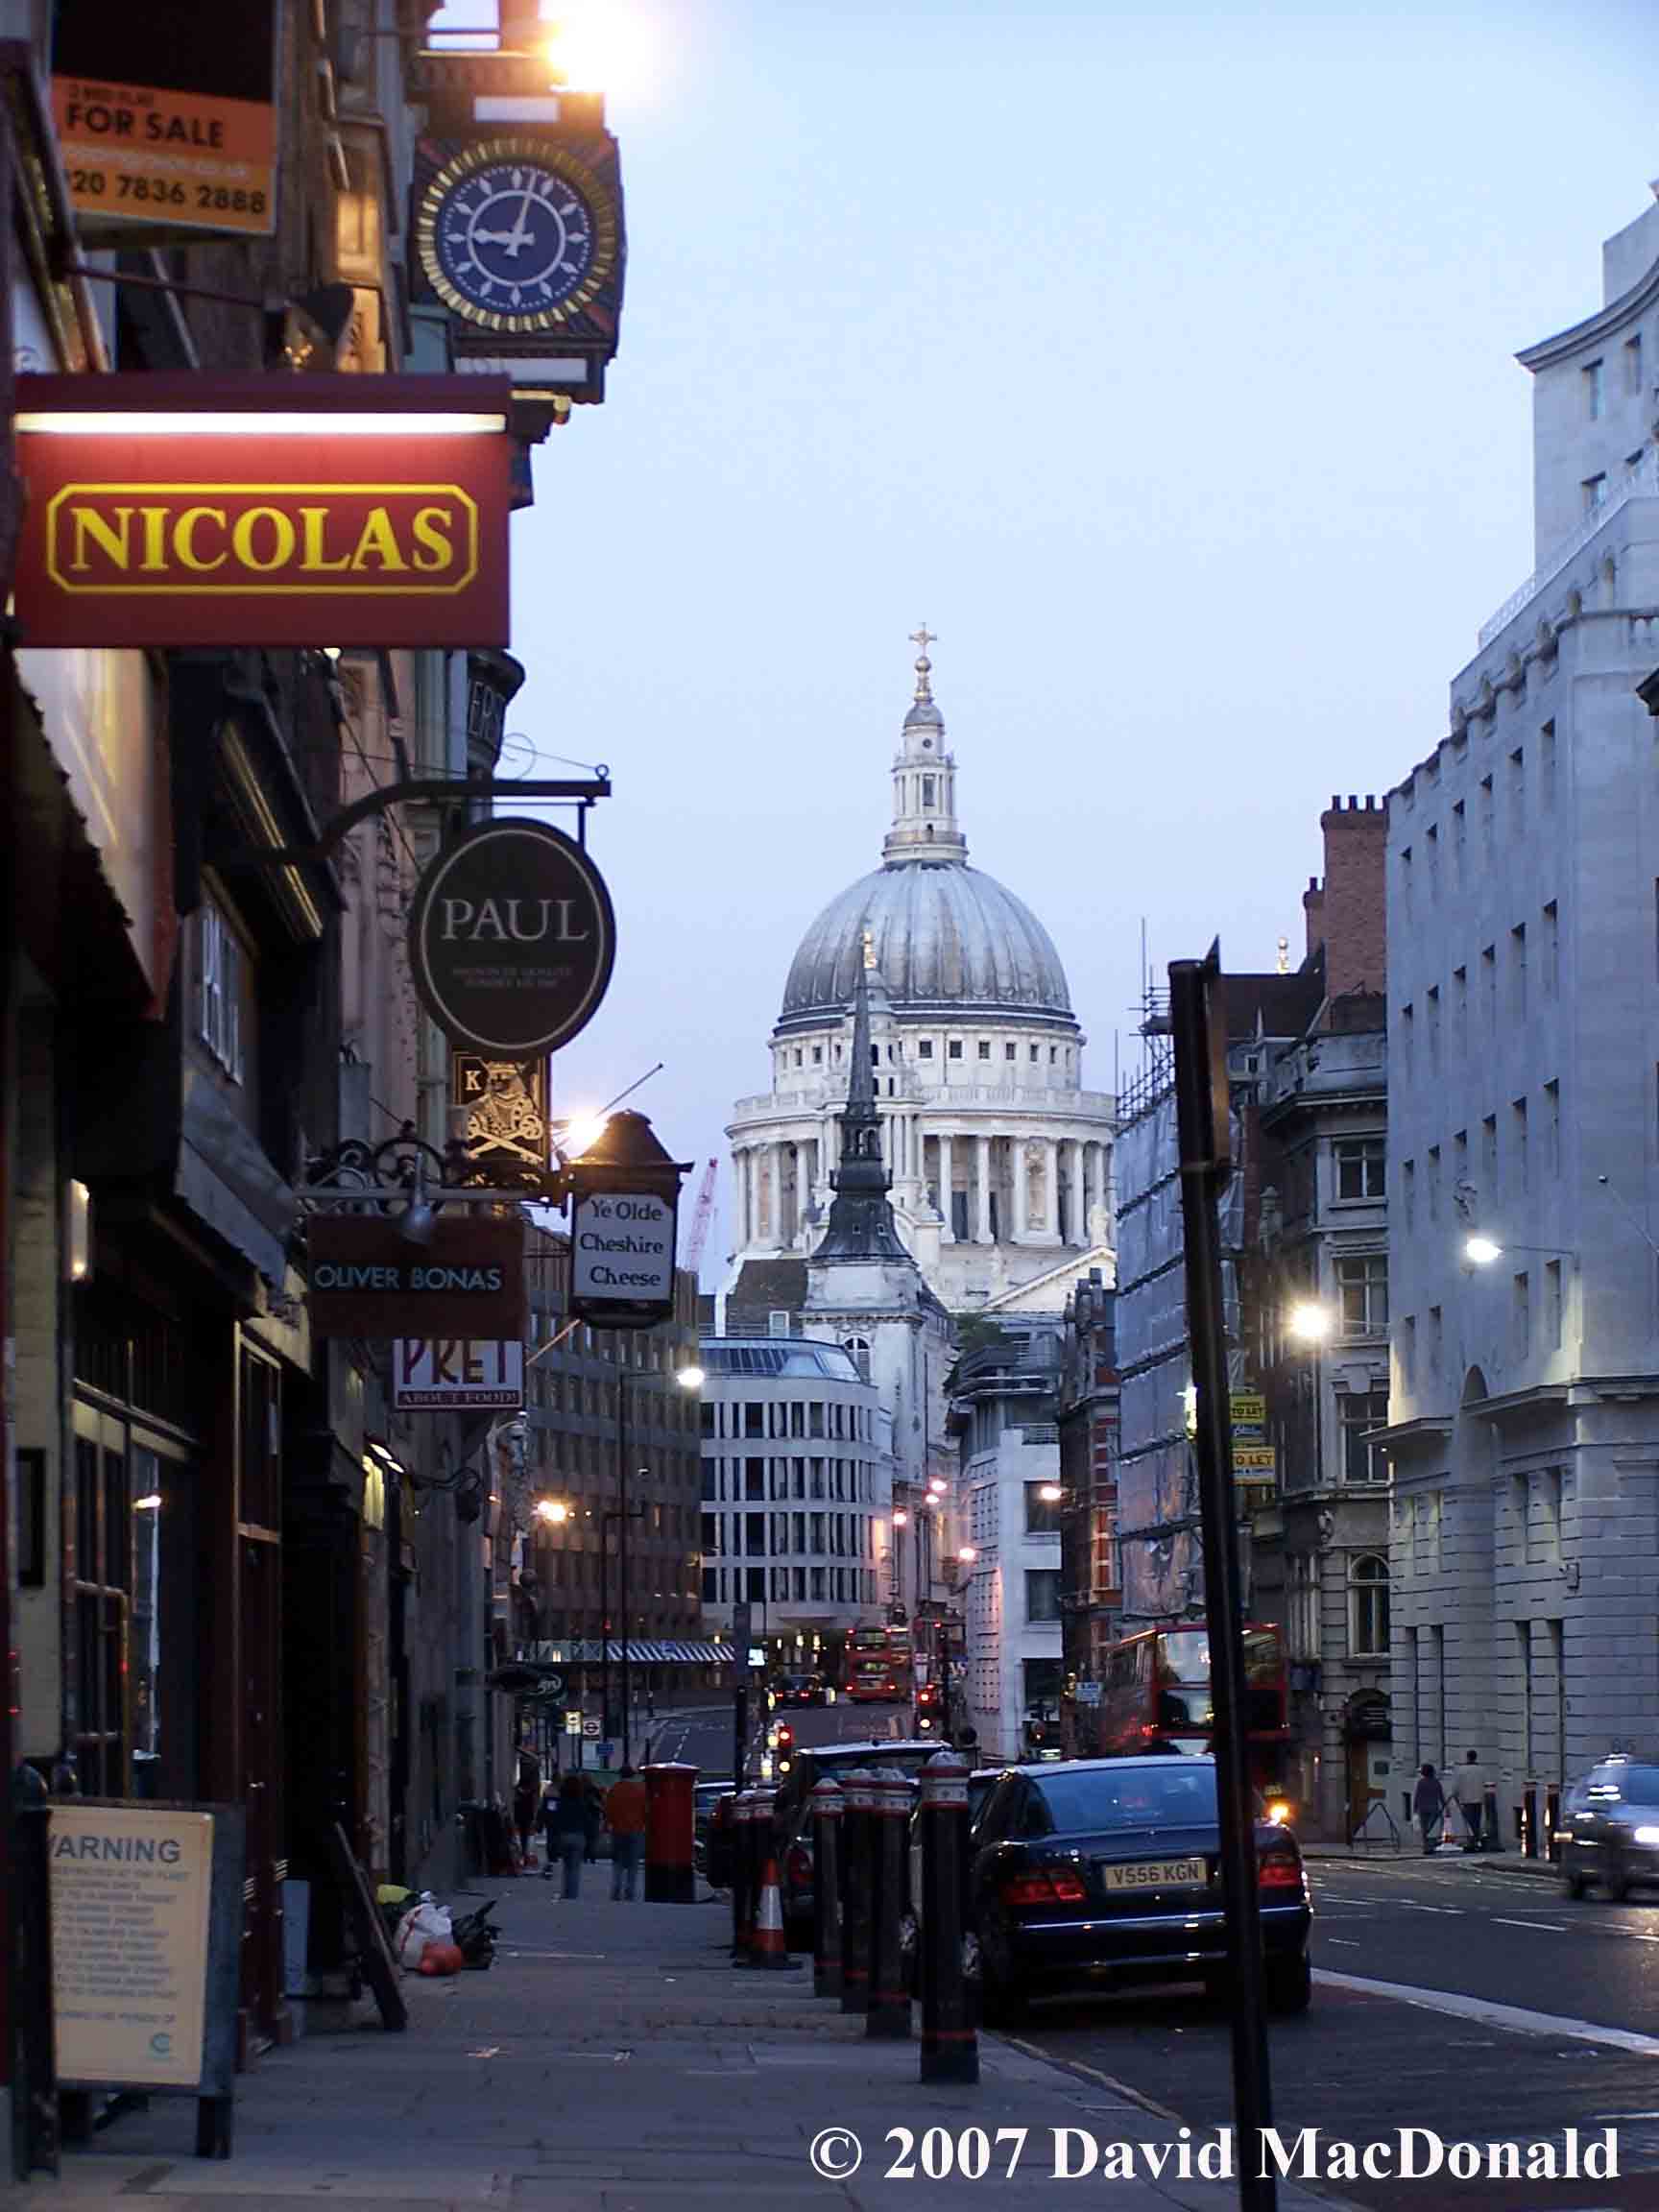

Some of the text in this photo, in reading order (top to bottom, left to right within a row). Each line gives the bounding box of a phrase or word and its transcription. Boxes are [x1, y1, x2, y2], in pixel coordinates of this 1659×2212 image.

[66, 103, 224, 148] FOR SALE
[64, 168, 266, 214] 20 7836 2888
[69, 506, 453, 571] NICOLAS
[441, 898, 589, 941] PAUL
[465, 1070, 481, 1091] K
[590, 1198, 662, 1221] Ye Olde
[580, 1233, 663, 1254] Cheshire
[314, 1265, 502, 1291] OLIVER BONAS
[590, 1265, 661, 1286] Cheese
[1250, 1453, 1273, 1466] LET
[1163, 1861, 1200, 1882] KGN
